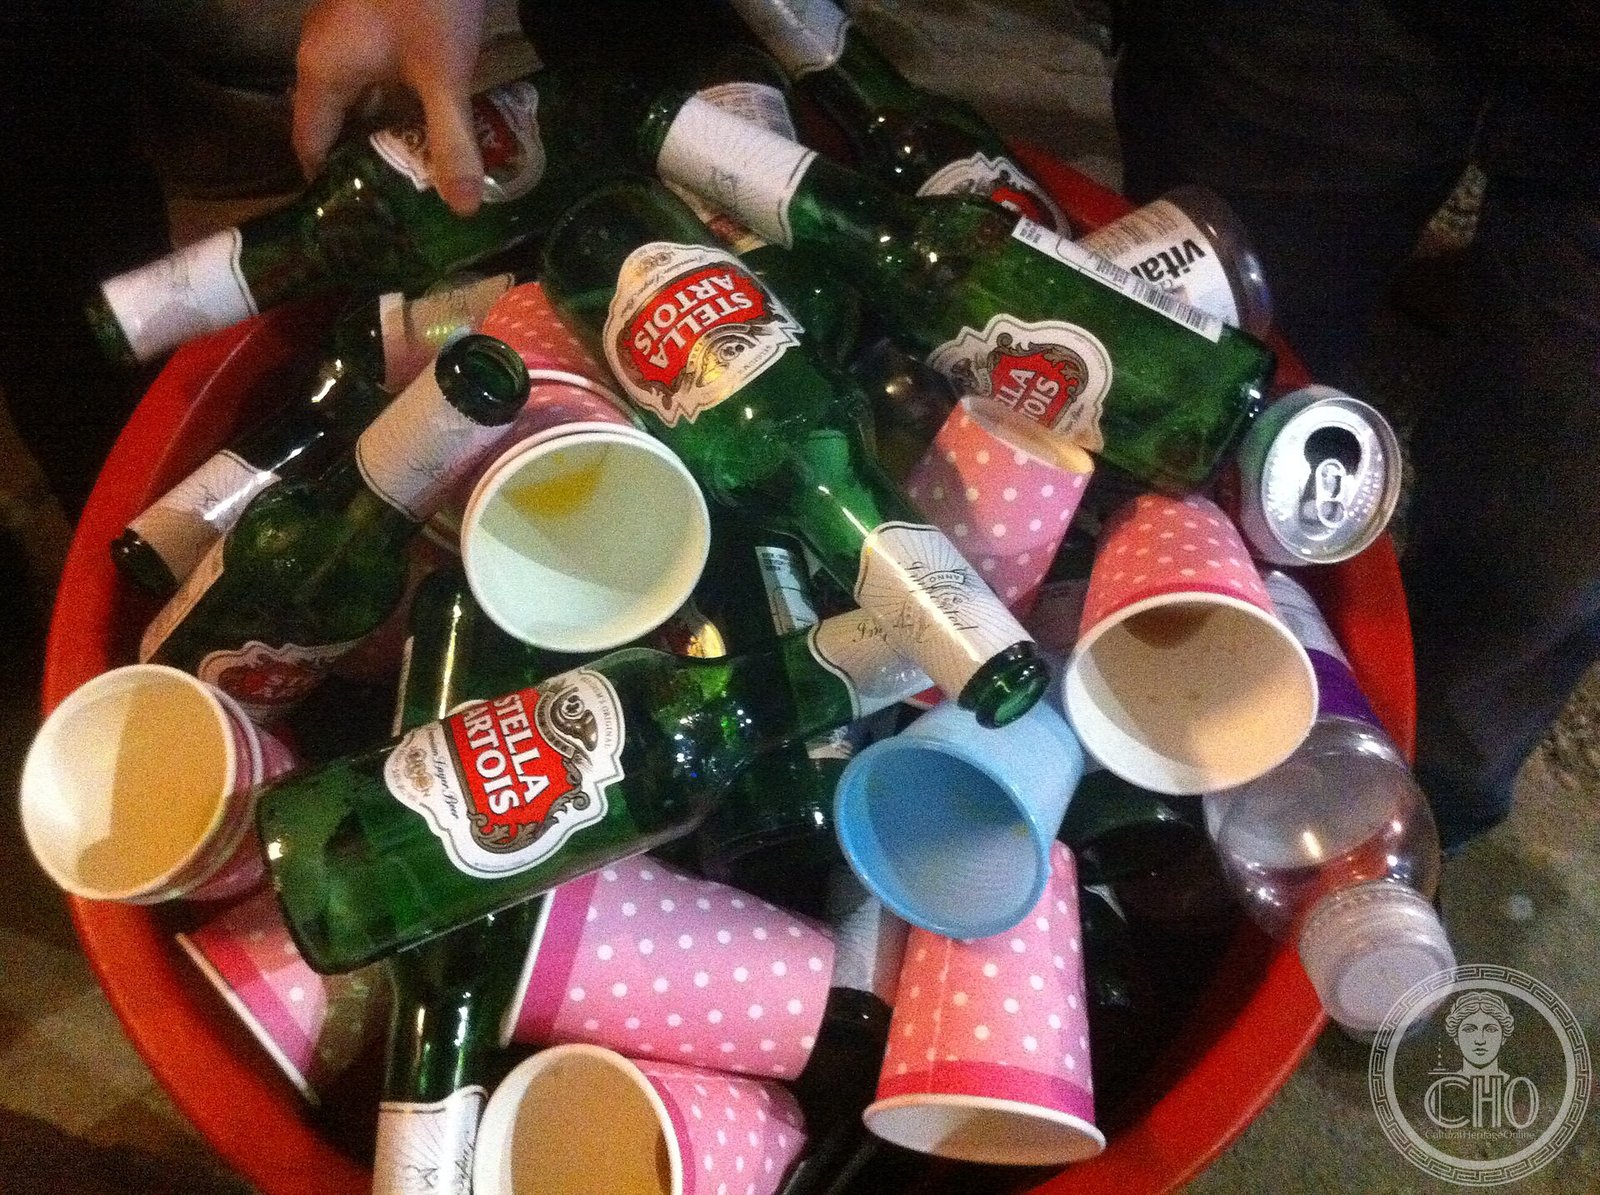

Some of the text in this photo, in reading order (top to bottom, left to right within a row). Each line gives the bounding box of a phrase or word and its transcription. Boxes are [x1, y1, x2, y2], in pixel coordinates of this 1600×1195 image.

[633, 273, 736, 356] ARTOIS
[648, 291, 754, 370] STELLA
[462, 706, 521, 815] ARTOIS
[494, 693, 550, 804] STELLA
